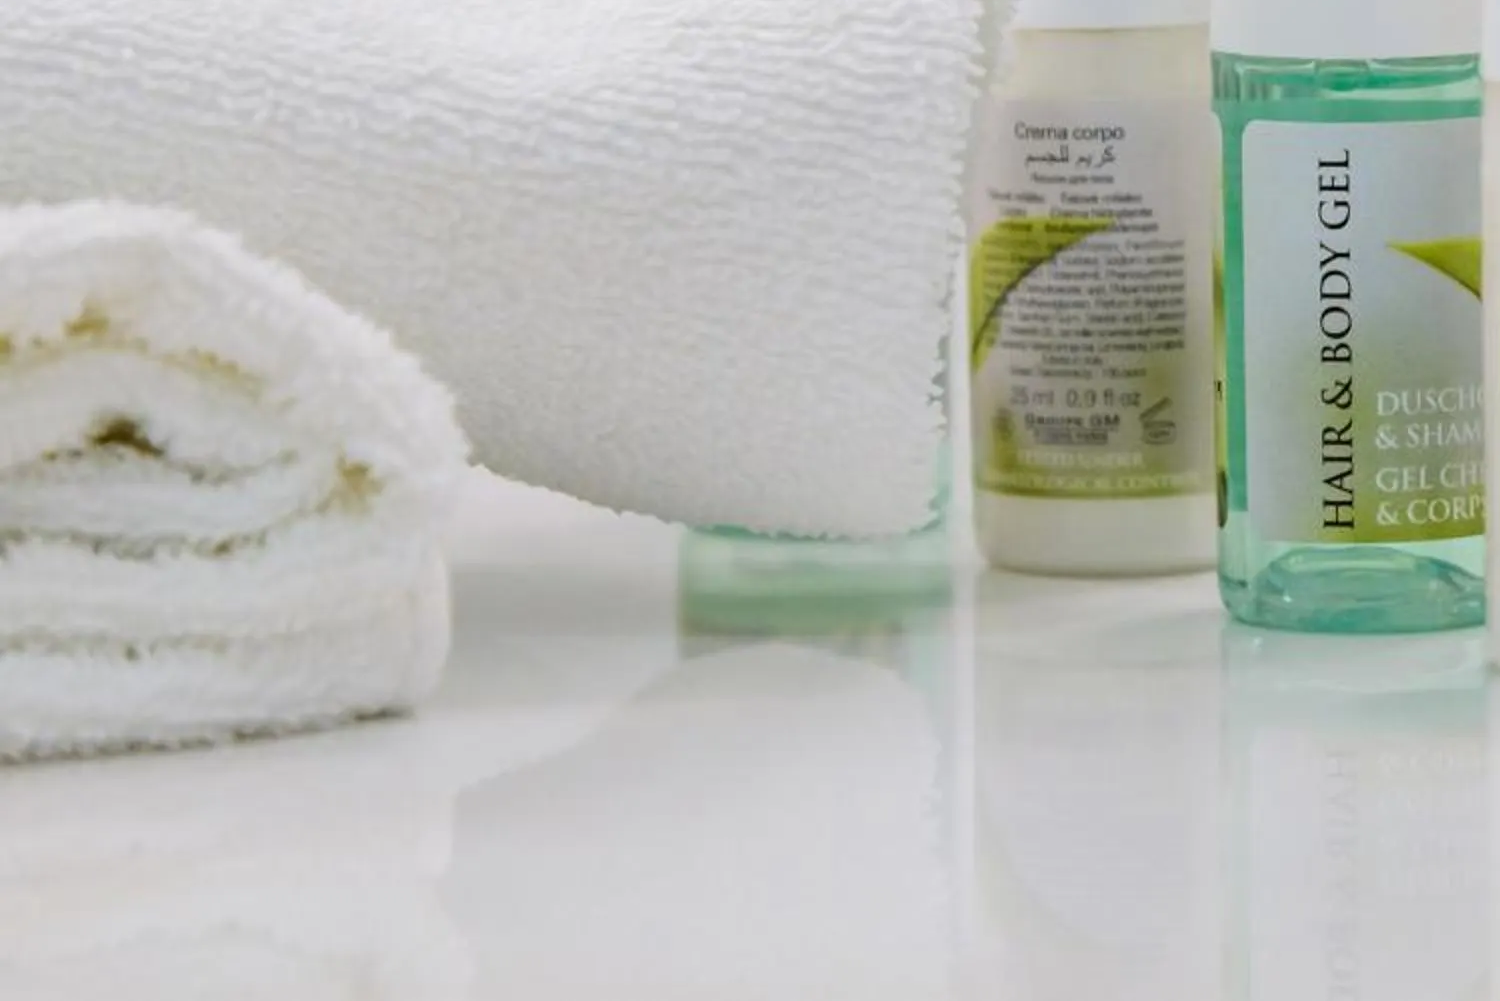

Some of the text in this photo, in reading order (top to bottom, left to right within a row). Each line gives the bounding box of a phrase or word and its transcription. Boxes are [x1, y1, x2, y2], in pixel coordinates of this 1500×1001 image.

[1014, 122, 1126, 143] Crema corpo
[1318, 149, 1354, 529] HAIR & BODY GEL
[1375, 423, 1400, 449] &
[1375, 465, 1435, 493] GEL
[1376, 501, 1401, 526] &
